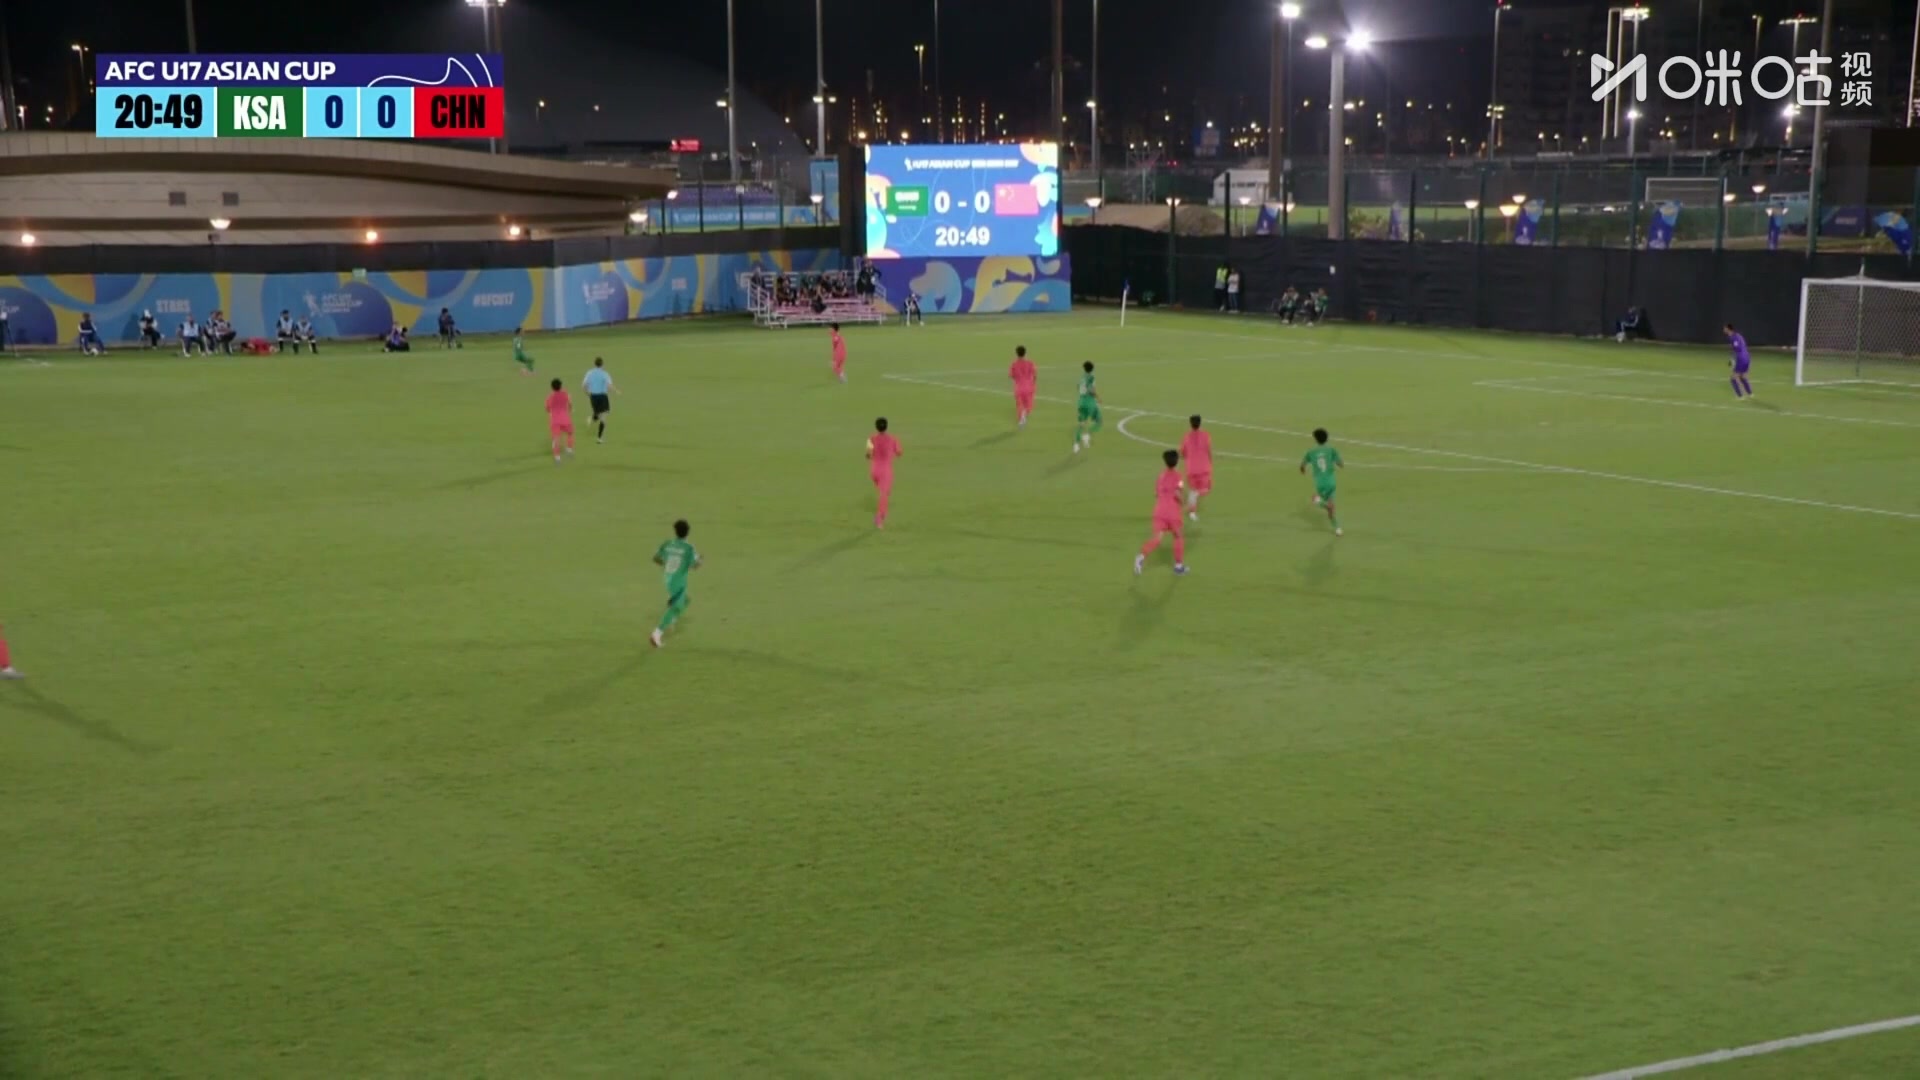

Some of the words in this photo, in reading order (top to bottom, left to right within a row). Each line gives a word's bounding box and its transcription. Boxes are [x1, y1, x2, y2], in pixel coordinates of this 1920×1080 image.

[934, 191, 950, 213] 0
[974, 191, 991, 213] 0
[935, 226, 991, 246] 20:49
